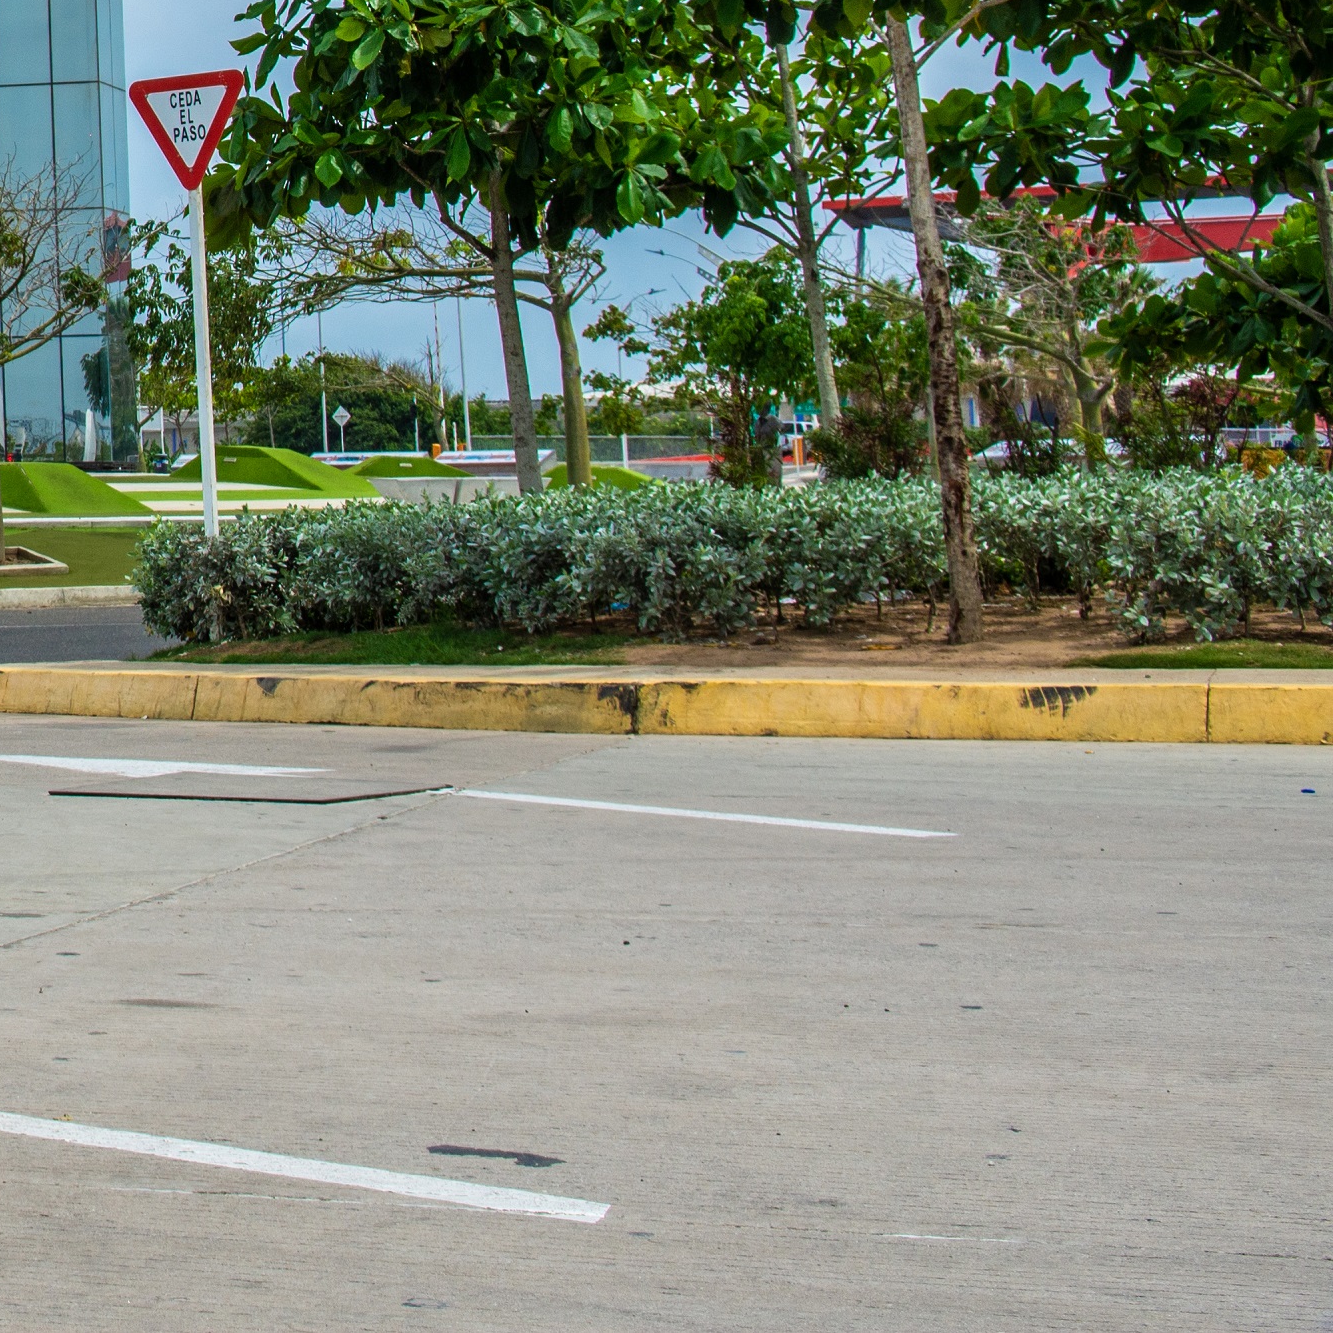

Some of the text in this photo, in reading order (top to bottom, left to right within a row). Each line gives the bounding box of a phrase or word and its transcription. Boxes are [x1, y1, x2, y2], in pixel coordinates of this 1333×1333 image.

[170, 90, 201, 108] CEDA
[179, 108, 194, 125] EL
[173, 124, 206, 142] PASO
